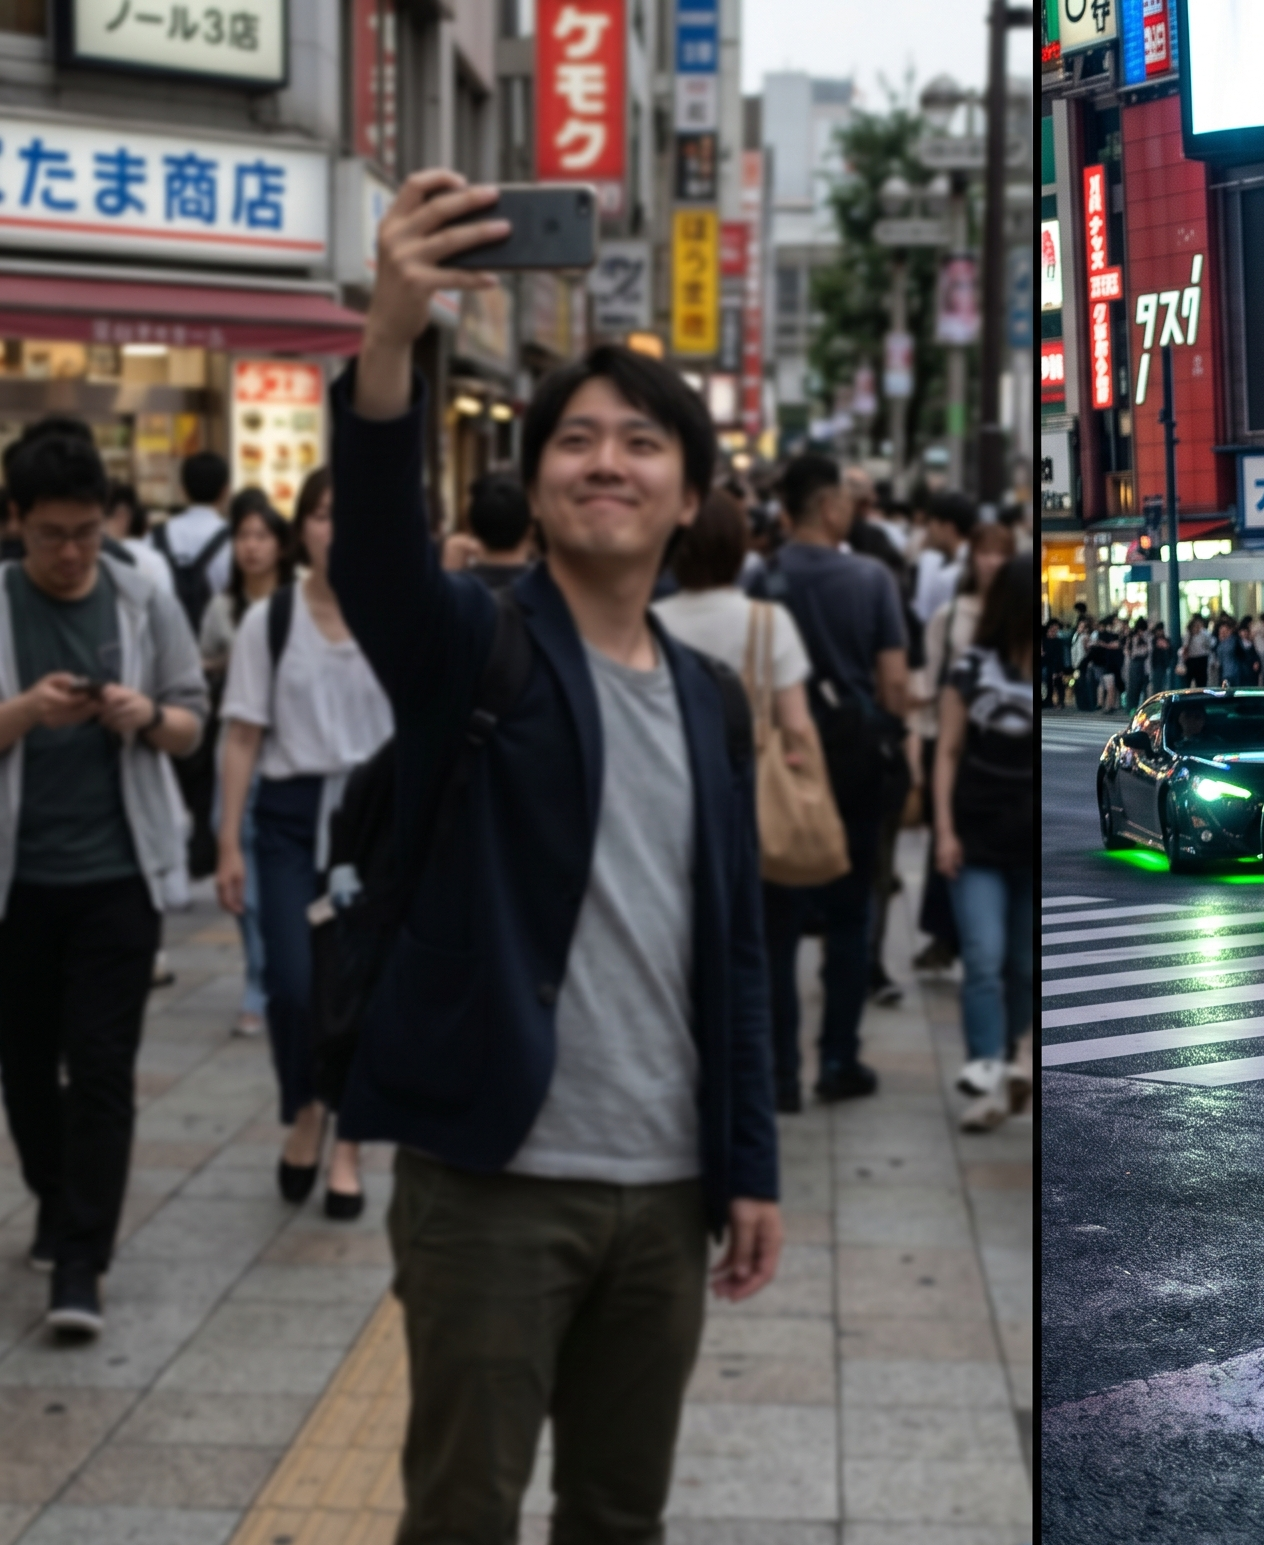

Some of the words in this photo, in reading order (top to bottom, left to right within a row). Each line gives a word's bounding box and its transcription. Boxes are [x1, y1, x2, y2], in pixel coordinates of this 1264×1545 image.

[553, 6, 611, 170] ケモク
[0, 136, 285, 231] たま商店
